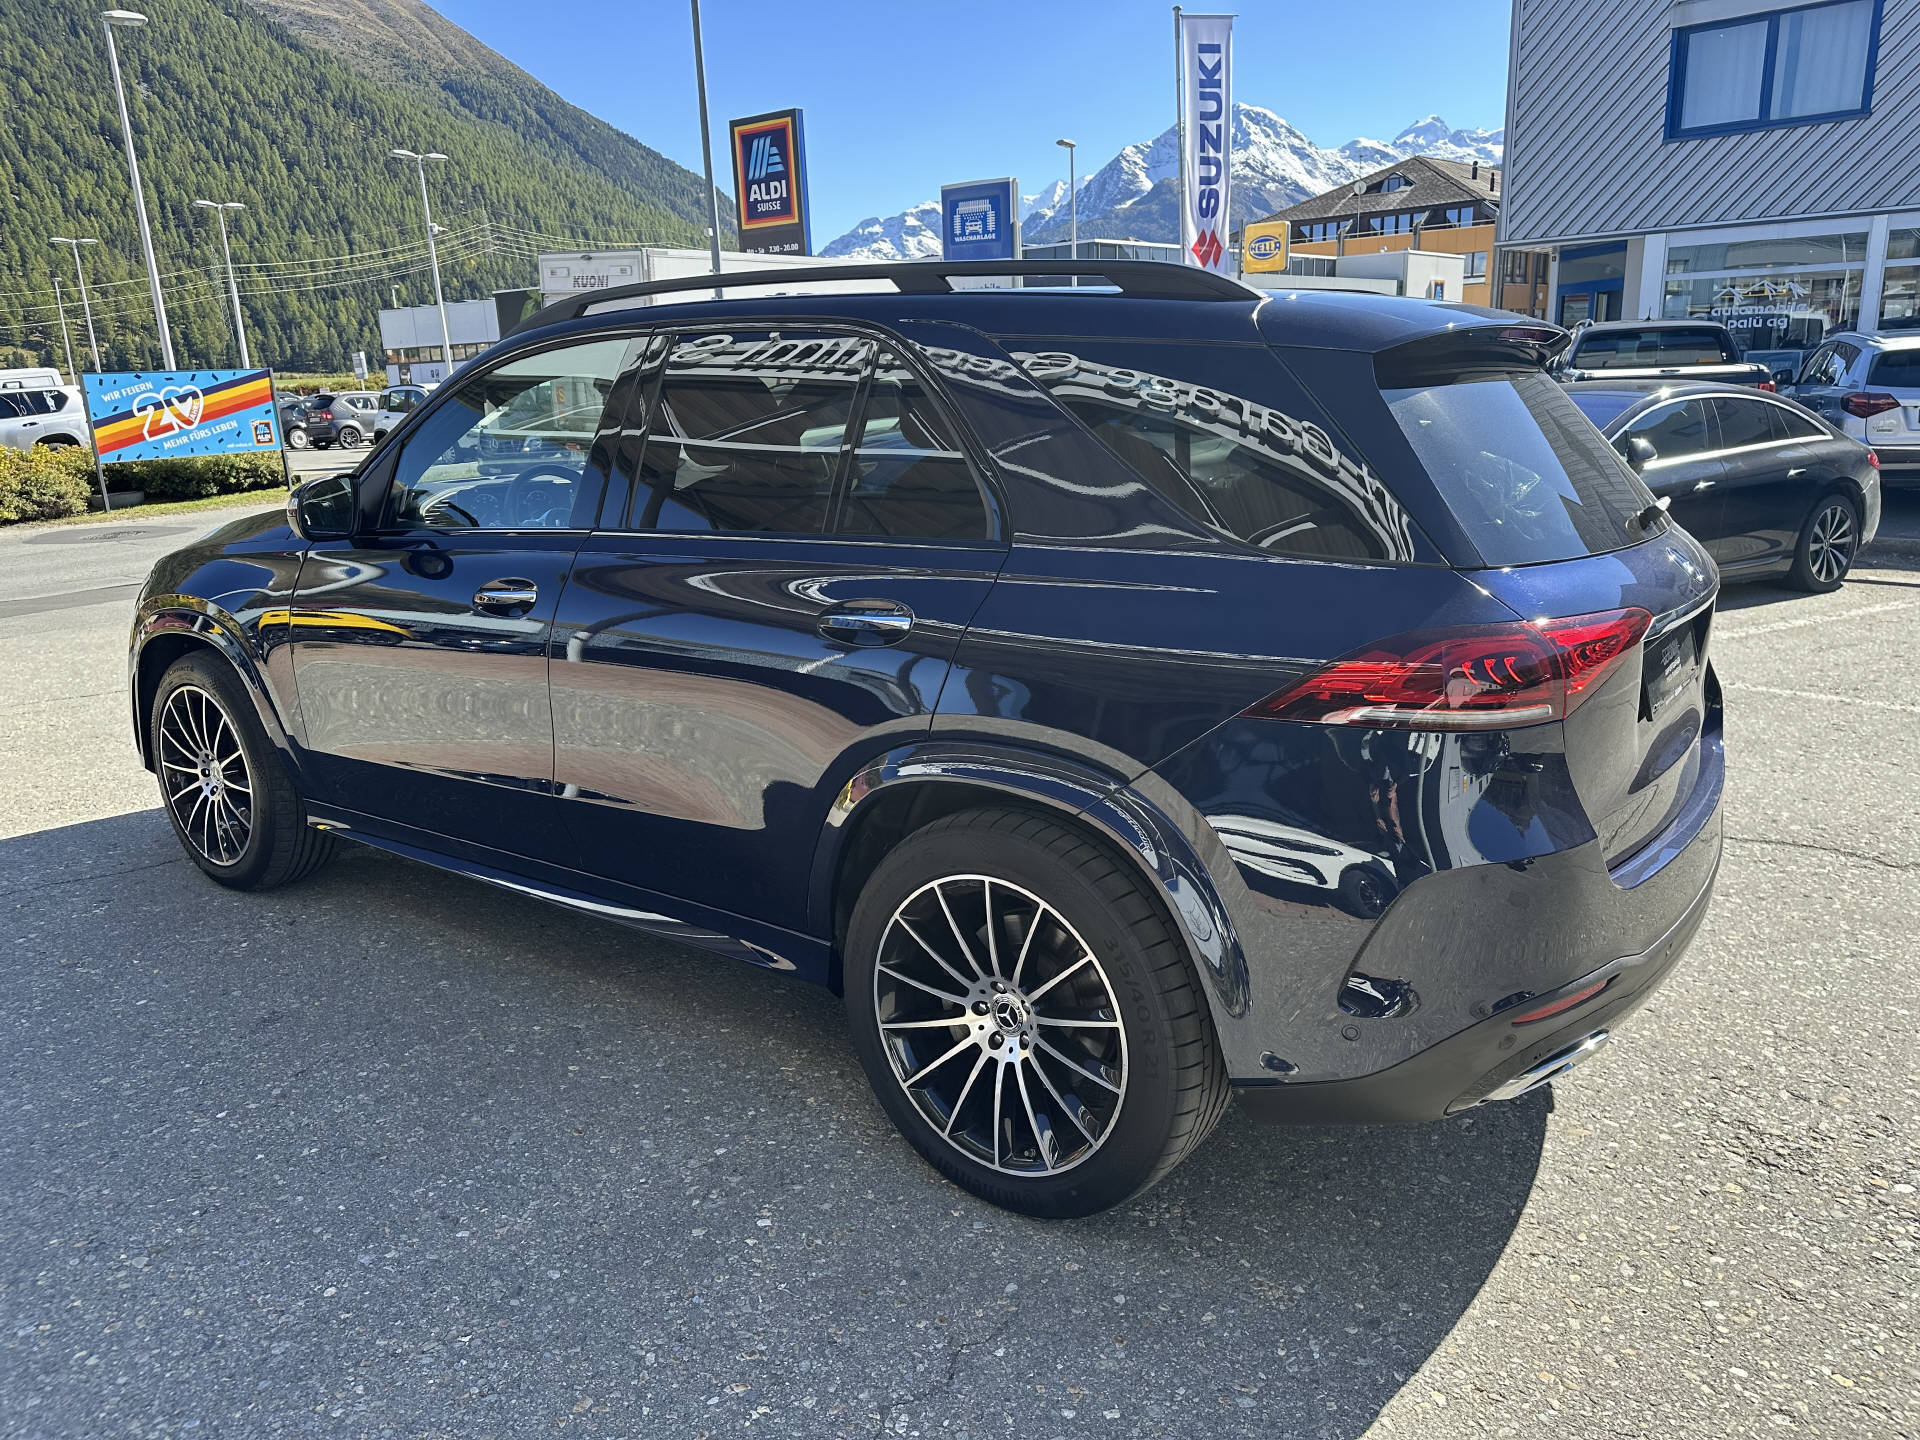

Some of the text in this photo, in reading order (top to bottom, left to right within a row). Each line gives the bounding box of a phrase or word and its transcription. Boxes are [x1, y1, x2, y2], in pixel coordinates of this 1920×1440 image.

[1198, 43, 1223, 219] SUZUKI
[750, 179, 787, 201] ALDI
[757, 200, 781, 212] SUISSE
[954, 233, 996, 242] WASCHANLAGE
[783, 243, 799, 252] 20.00
[1250, 240, 1281, 252] HELLA
[573, 275, 609, 288] KUONI
[1711, 301, 1808, 317] automobile
[1727, 315, 1788, 331] palü ag
[101, 382, 153, 402] WIR FEIERN
[189, 400, 200, 422] JAHRE
[163, 420, 238, 450] MEHR FÜRS LEBEN
